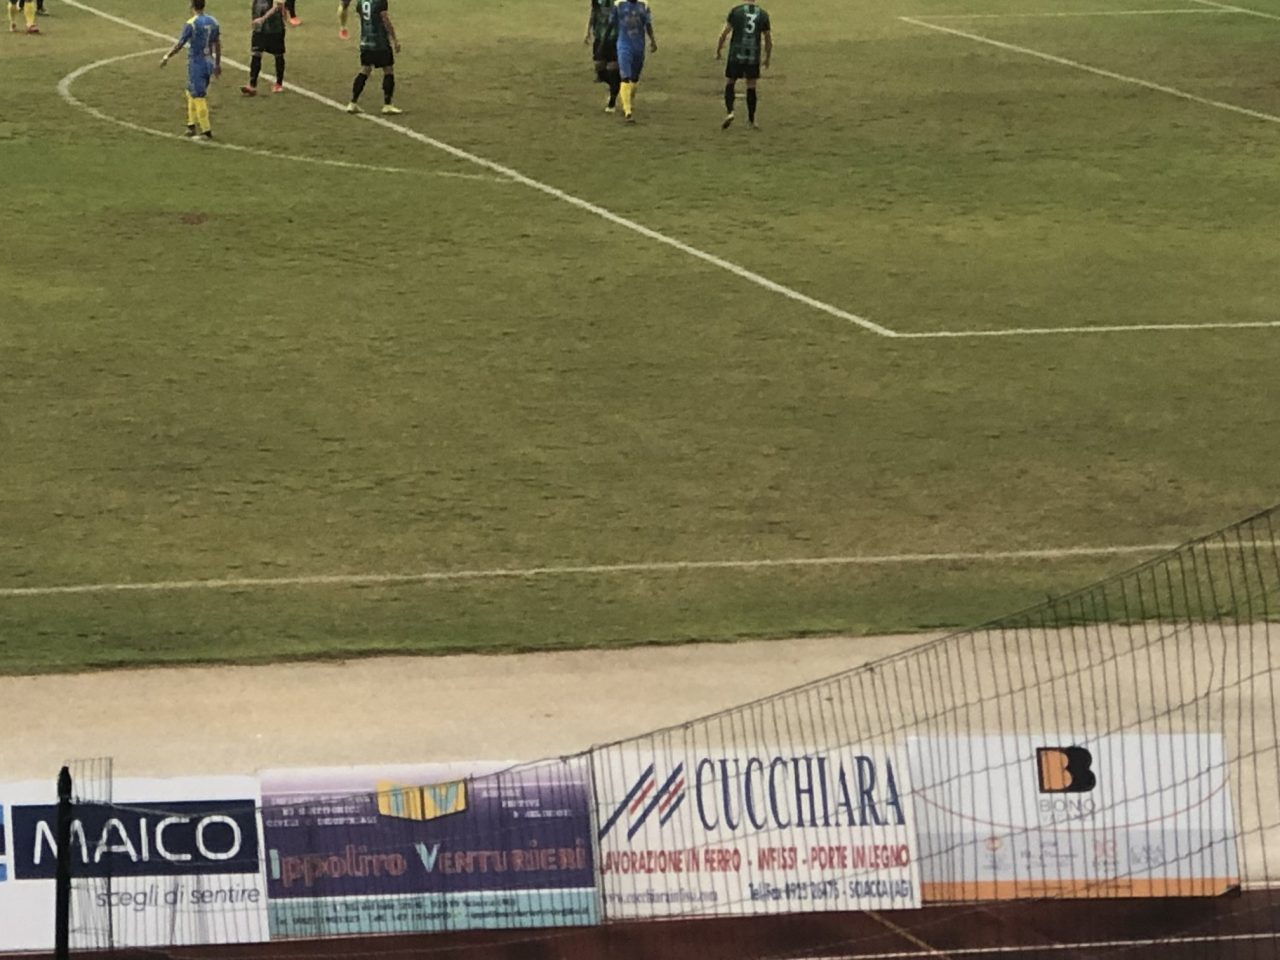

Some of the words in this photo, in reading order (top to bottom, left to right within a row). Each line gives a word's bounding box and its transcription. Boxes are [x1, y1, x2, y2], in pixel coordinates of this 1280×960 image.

[361, 1, 372, 21] 9
[744, 12, 758, 34] 3
[695, 755, 906, 832] CUCCHIARA
[33, 814, 242, 865] MAICO
[704, 847, 741, 873] FERRO
[810, 844, 848, 870] PORTE
[869, 843, 910, 869] LEGNO
[96, 886, 158, 911] scegli
[164, 884, 184, 907] di
[189, 884, 260, 904] sentire
